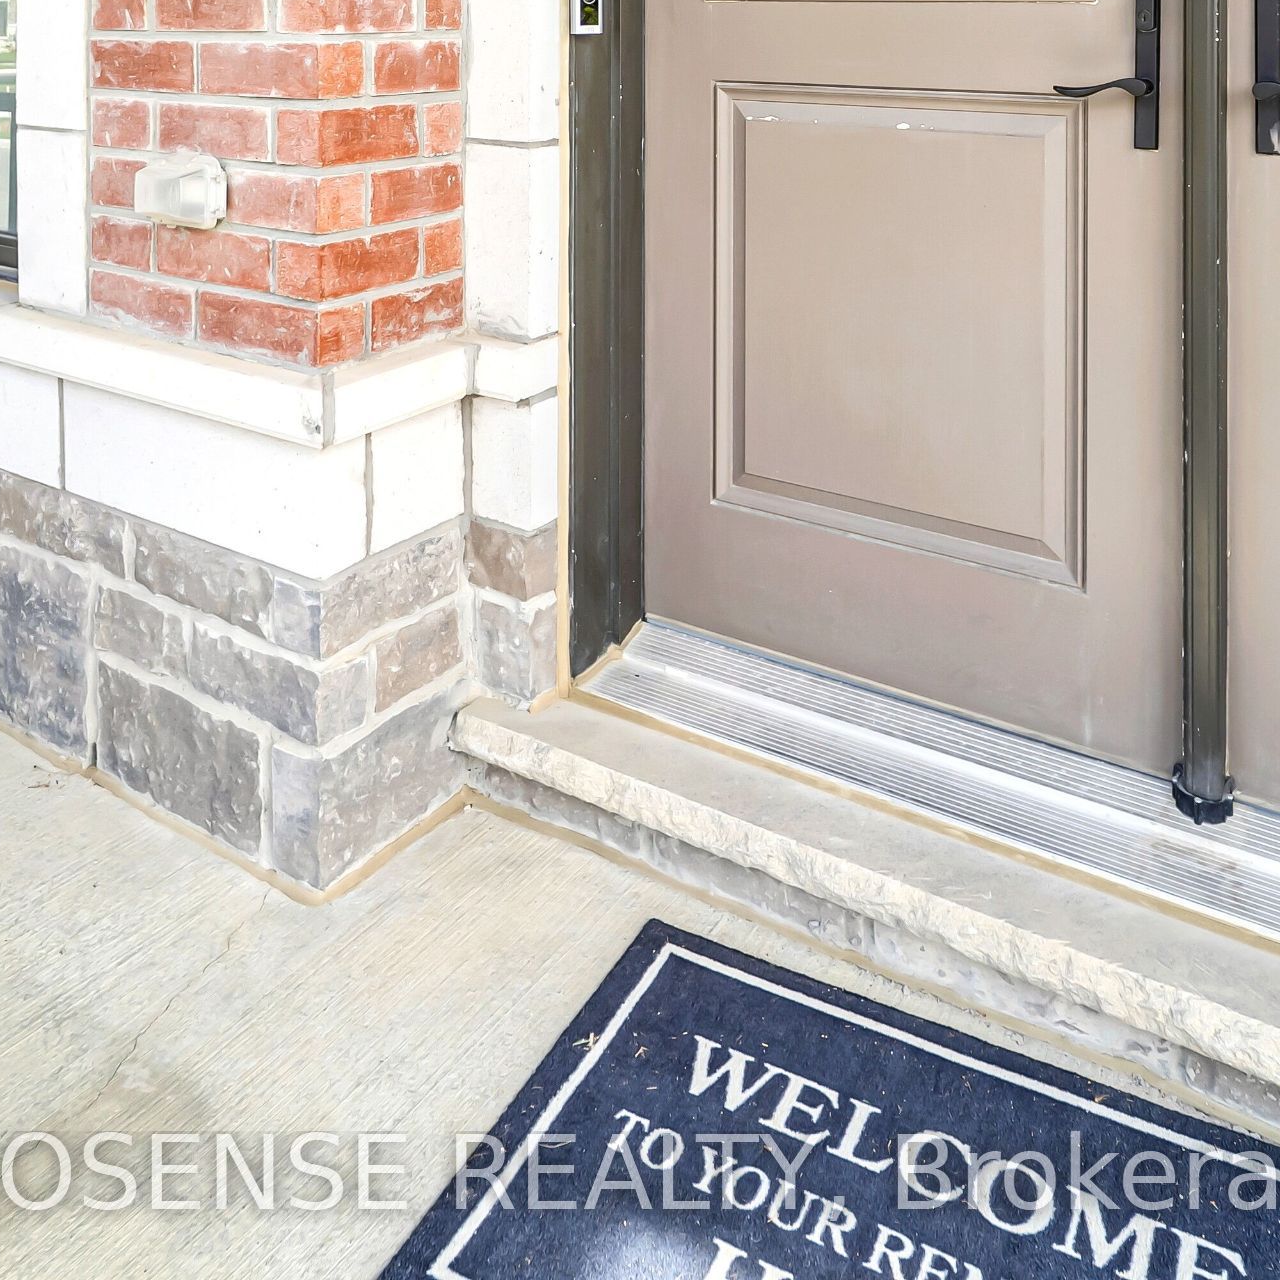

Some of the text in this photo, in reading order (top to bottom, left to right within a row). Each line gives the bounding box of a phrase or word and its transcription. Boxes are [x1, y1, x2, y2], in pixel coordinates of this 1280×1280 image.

[606, 1107, 685, 1171] TO
[692, 1144, 857, 1258] YOUR
[687, 1034, 1247, 1280] WELCOME
